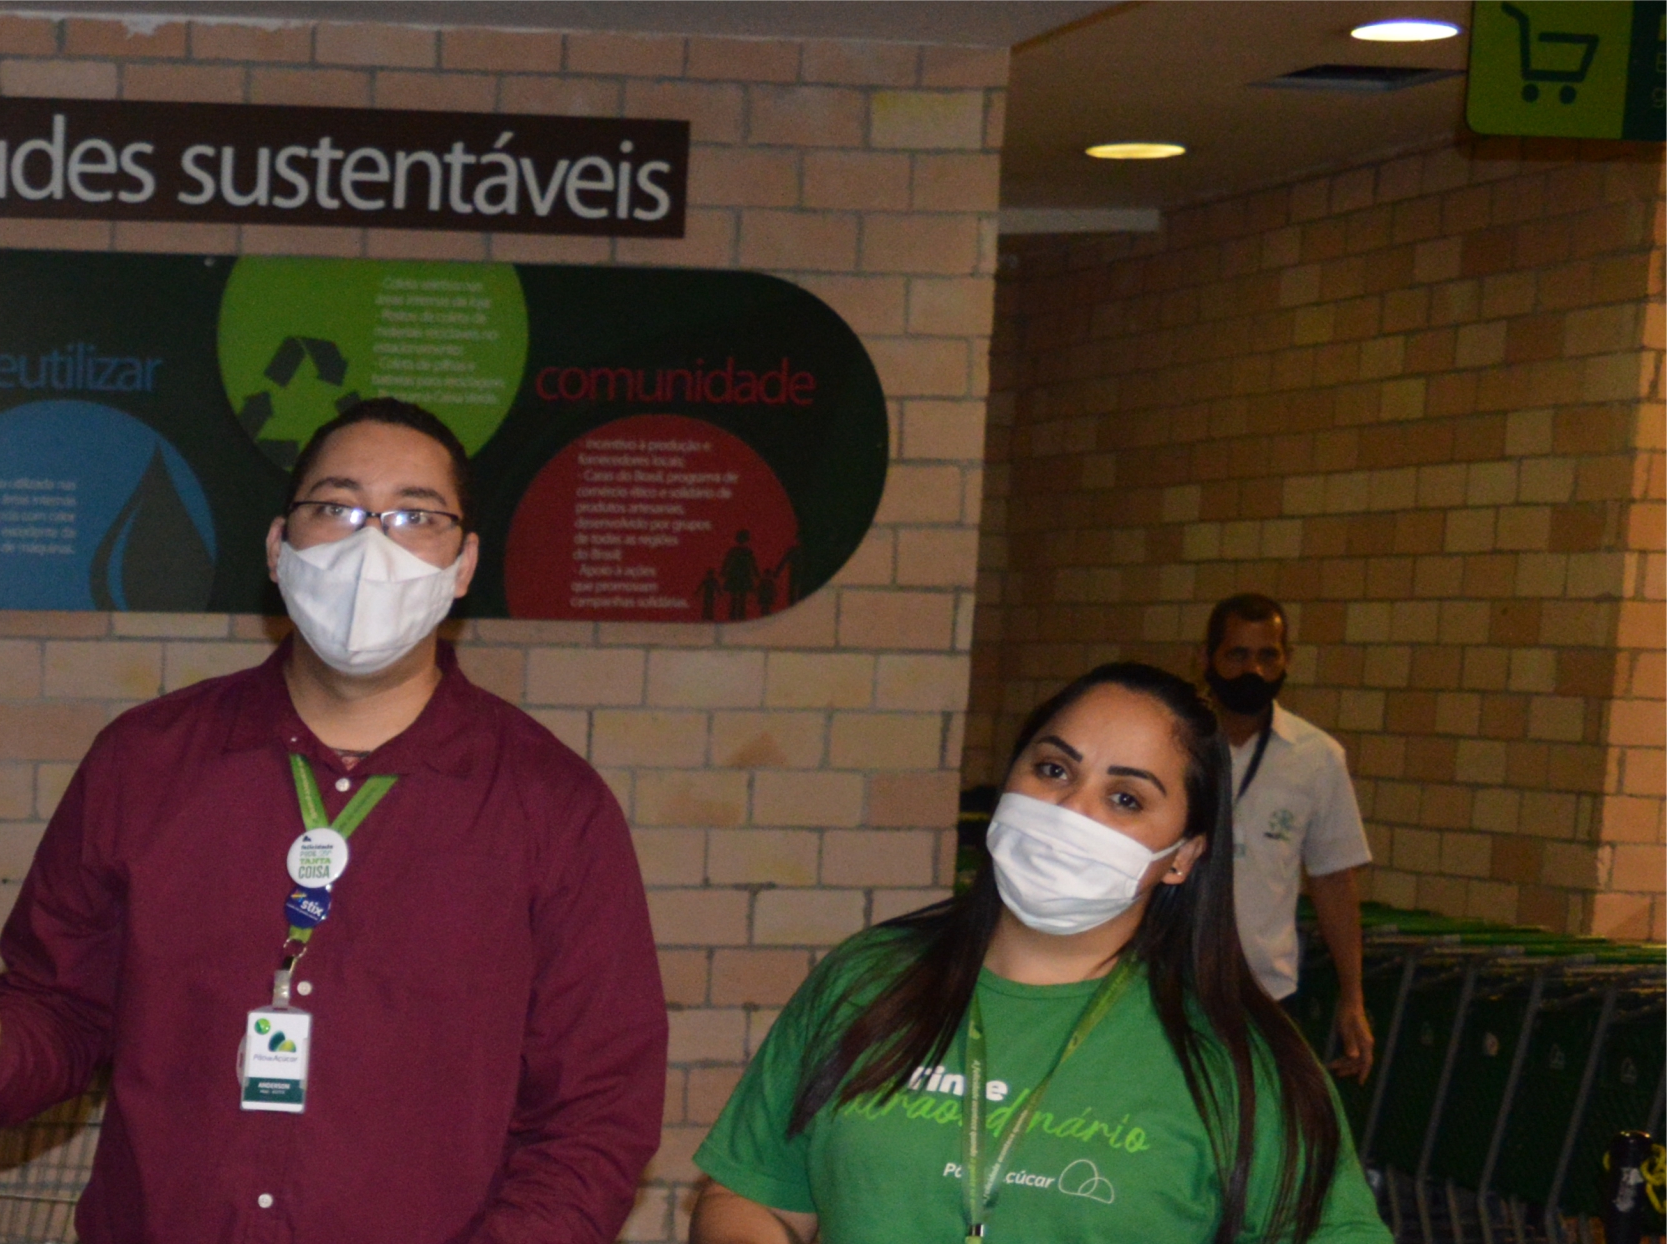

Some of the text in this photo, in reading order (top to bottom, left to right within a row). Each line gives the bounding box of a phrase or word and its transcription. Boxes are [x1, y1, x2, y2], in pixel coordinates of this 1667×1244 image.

[176, 131, 671, 221] sustentáveis
[535, 358, 816, 406] comunidade
[298, 866, 330, 879] COISA
[300, 899, 324, 917] stix
